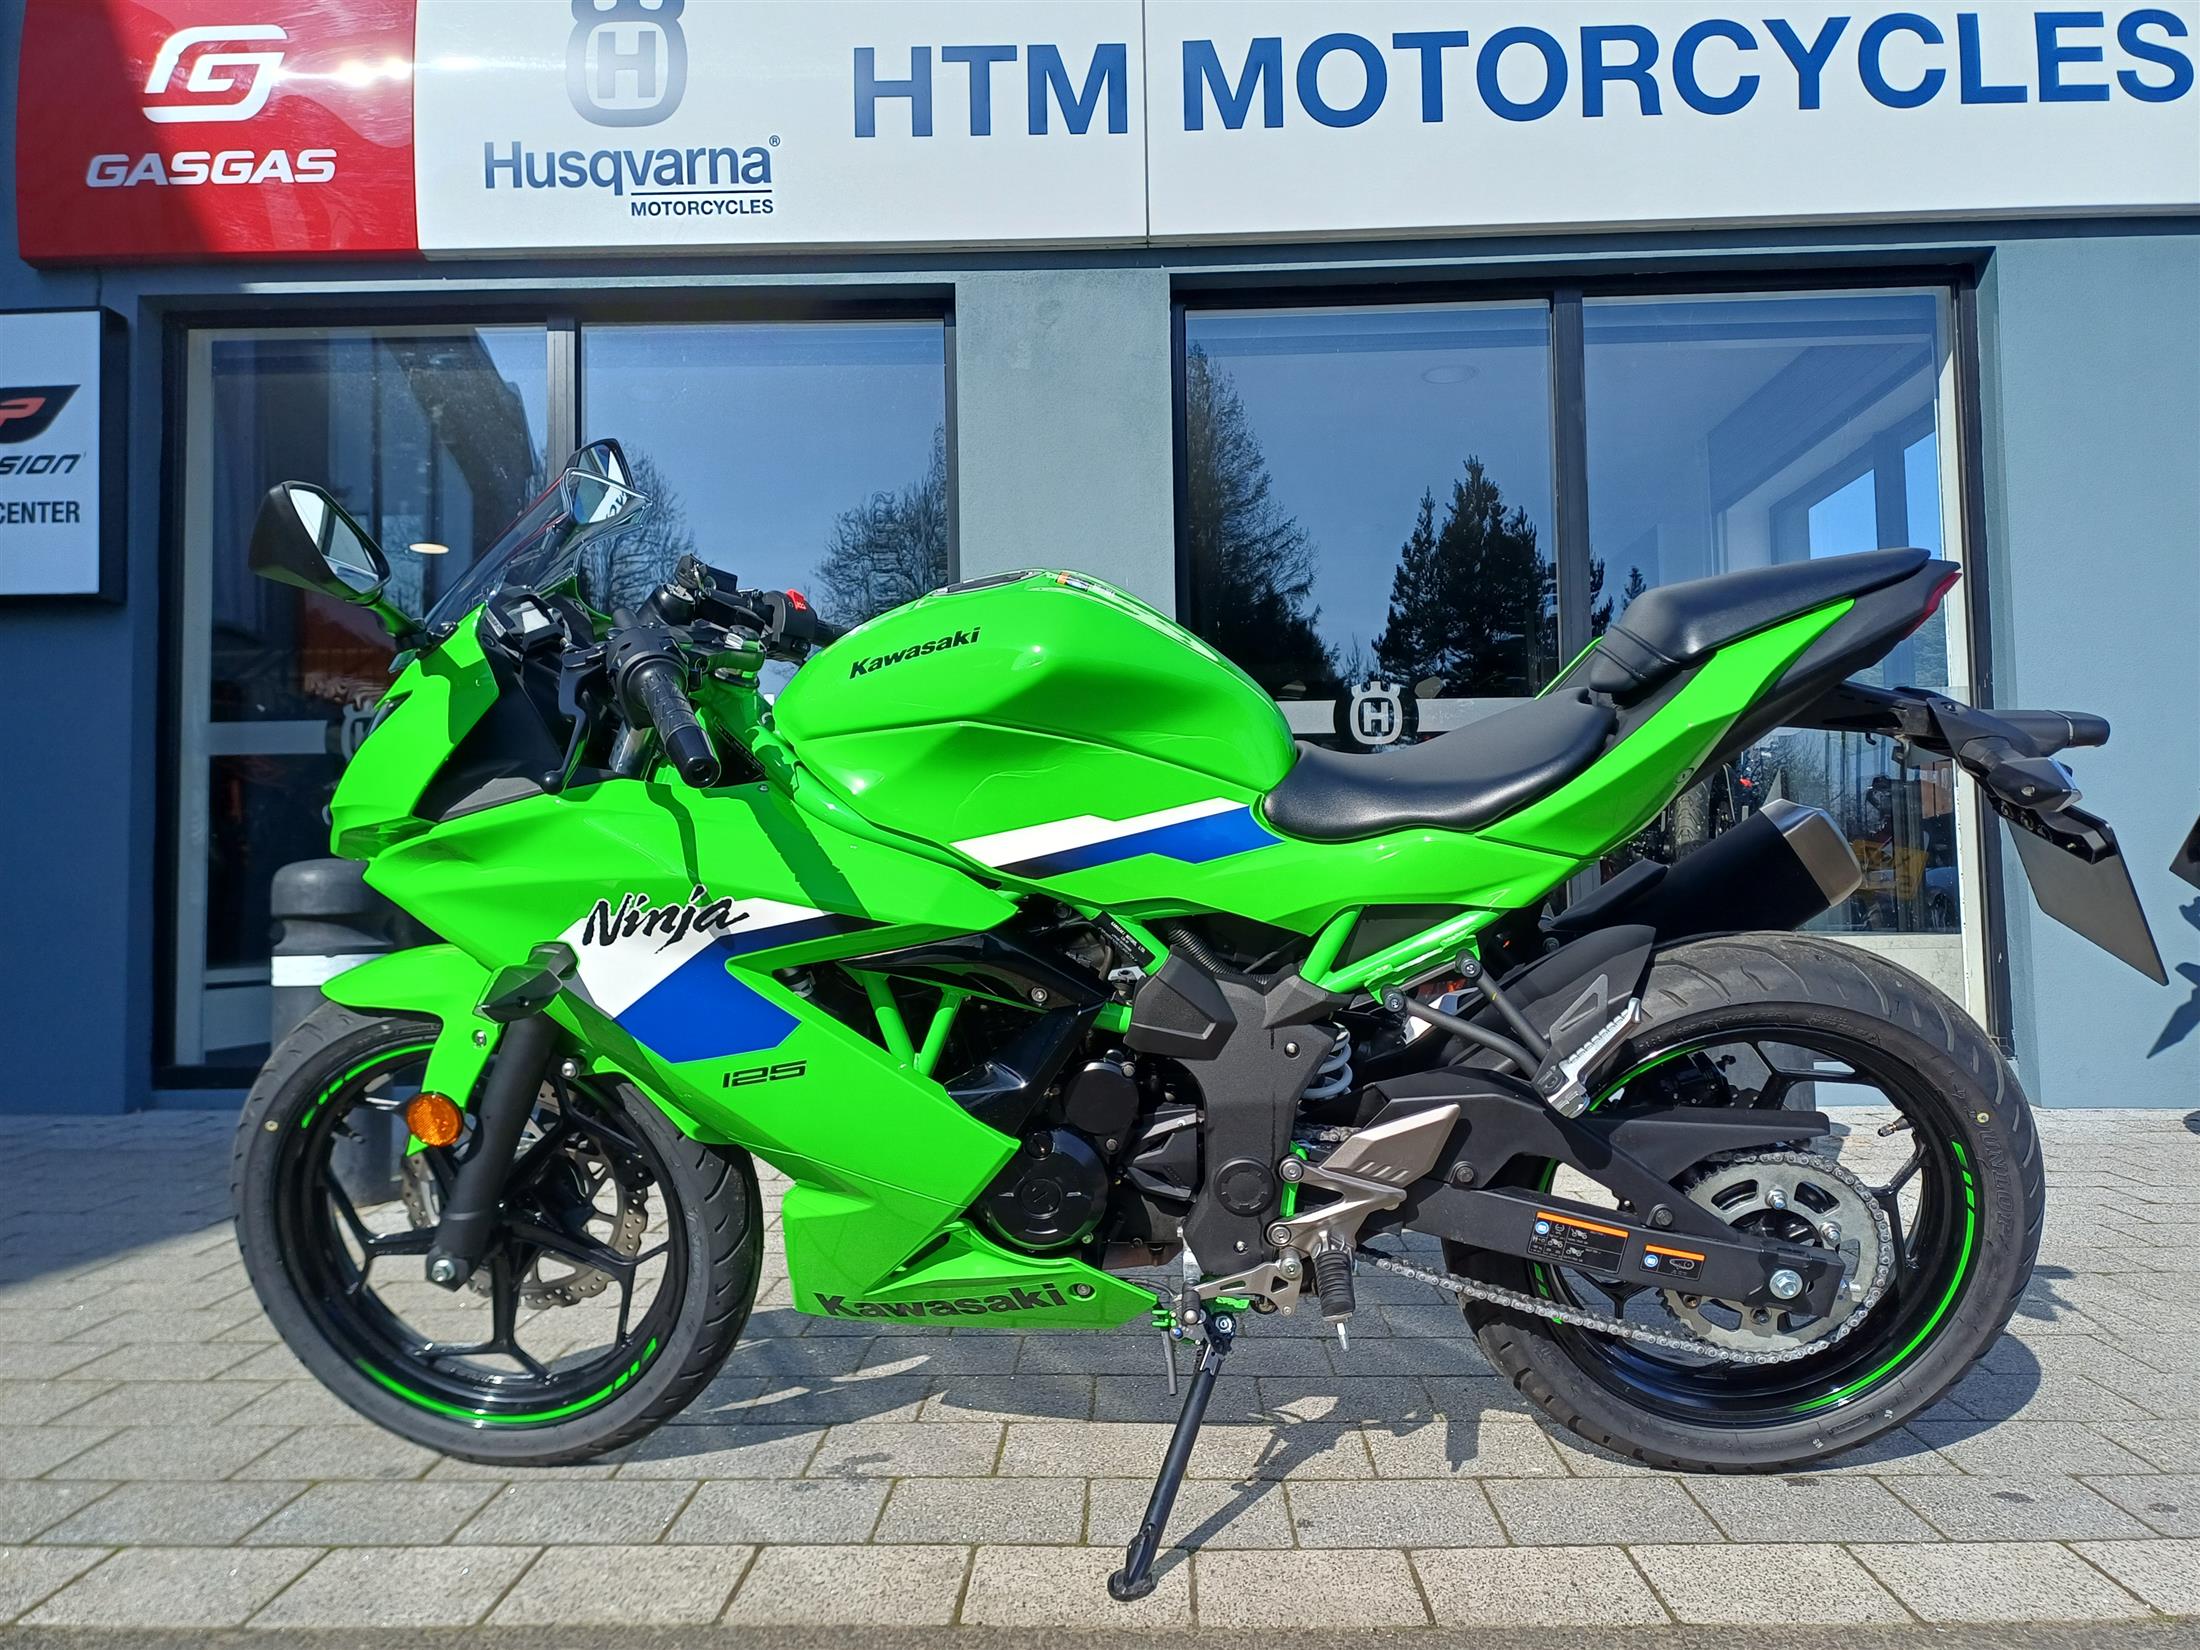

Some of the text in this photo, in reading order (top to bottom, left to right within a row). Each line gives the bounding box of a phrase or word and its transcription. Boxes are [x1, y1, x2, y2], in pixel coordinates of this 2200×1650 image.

[853, 9, 2195, 138] HTM MOTORCYCLES
[86, 148, 338, 188] GASGAS
[631, 199, 774, 216] MOTORCYCLES
[849, 626, 981, 679] Kawasaki
[582, 885, 750, 954] Ninja
[722, 1060, 807, 1088] 125
[813, 1283, 1068, 1318] Kawasaki
